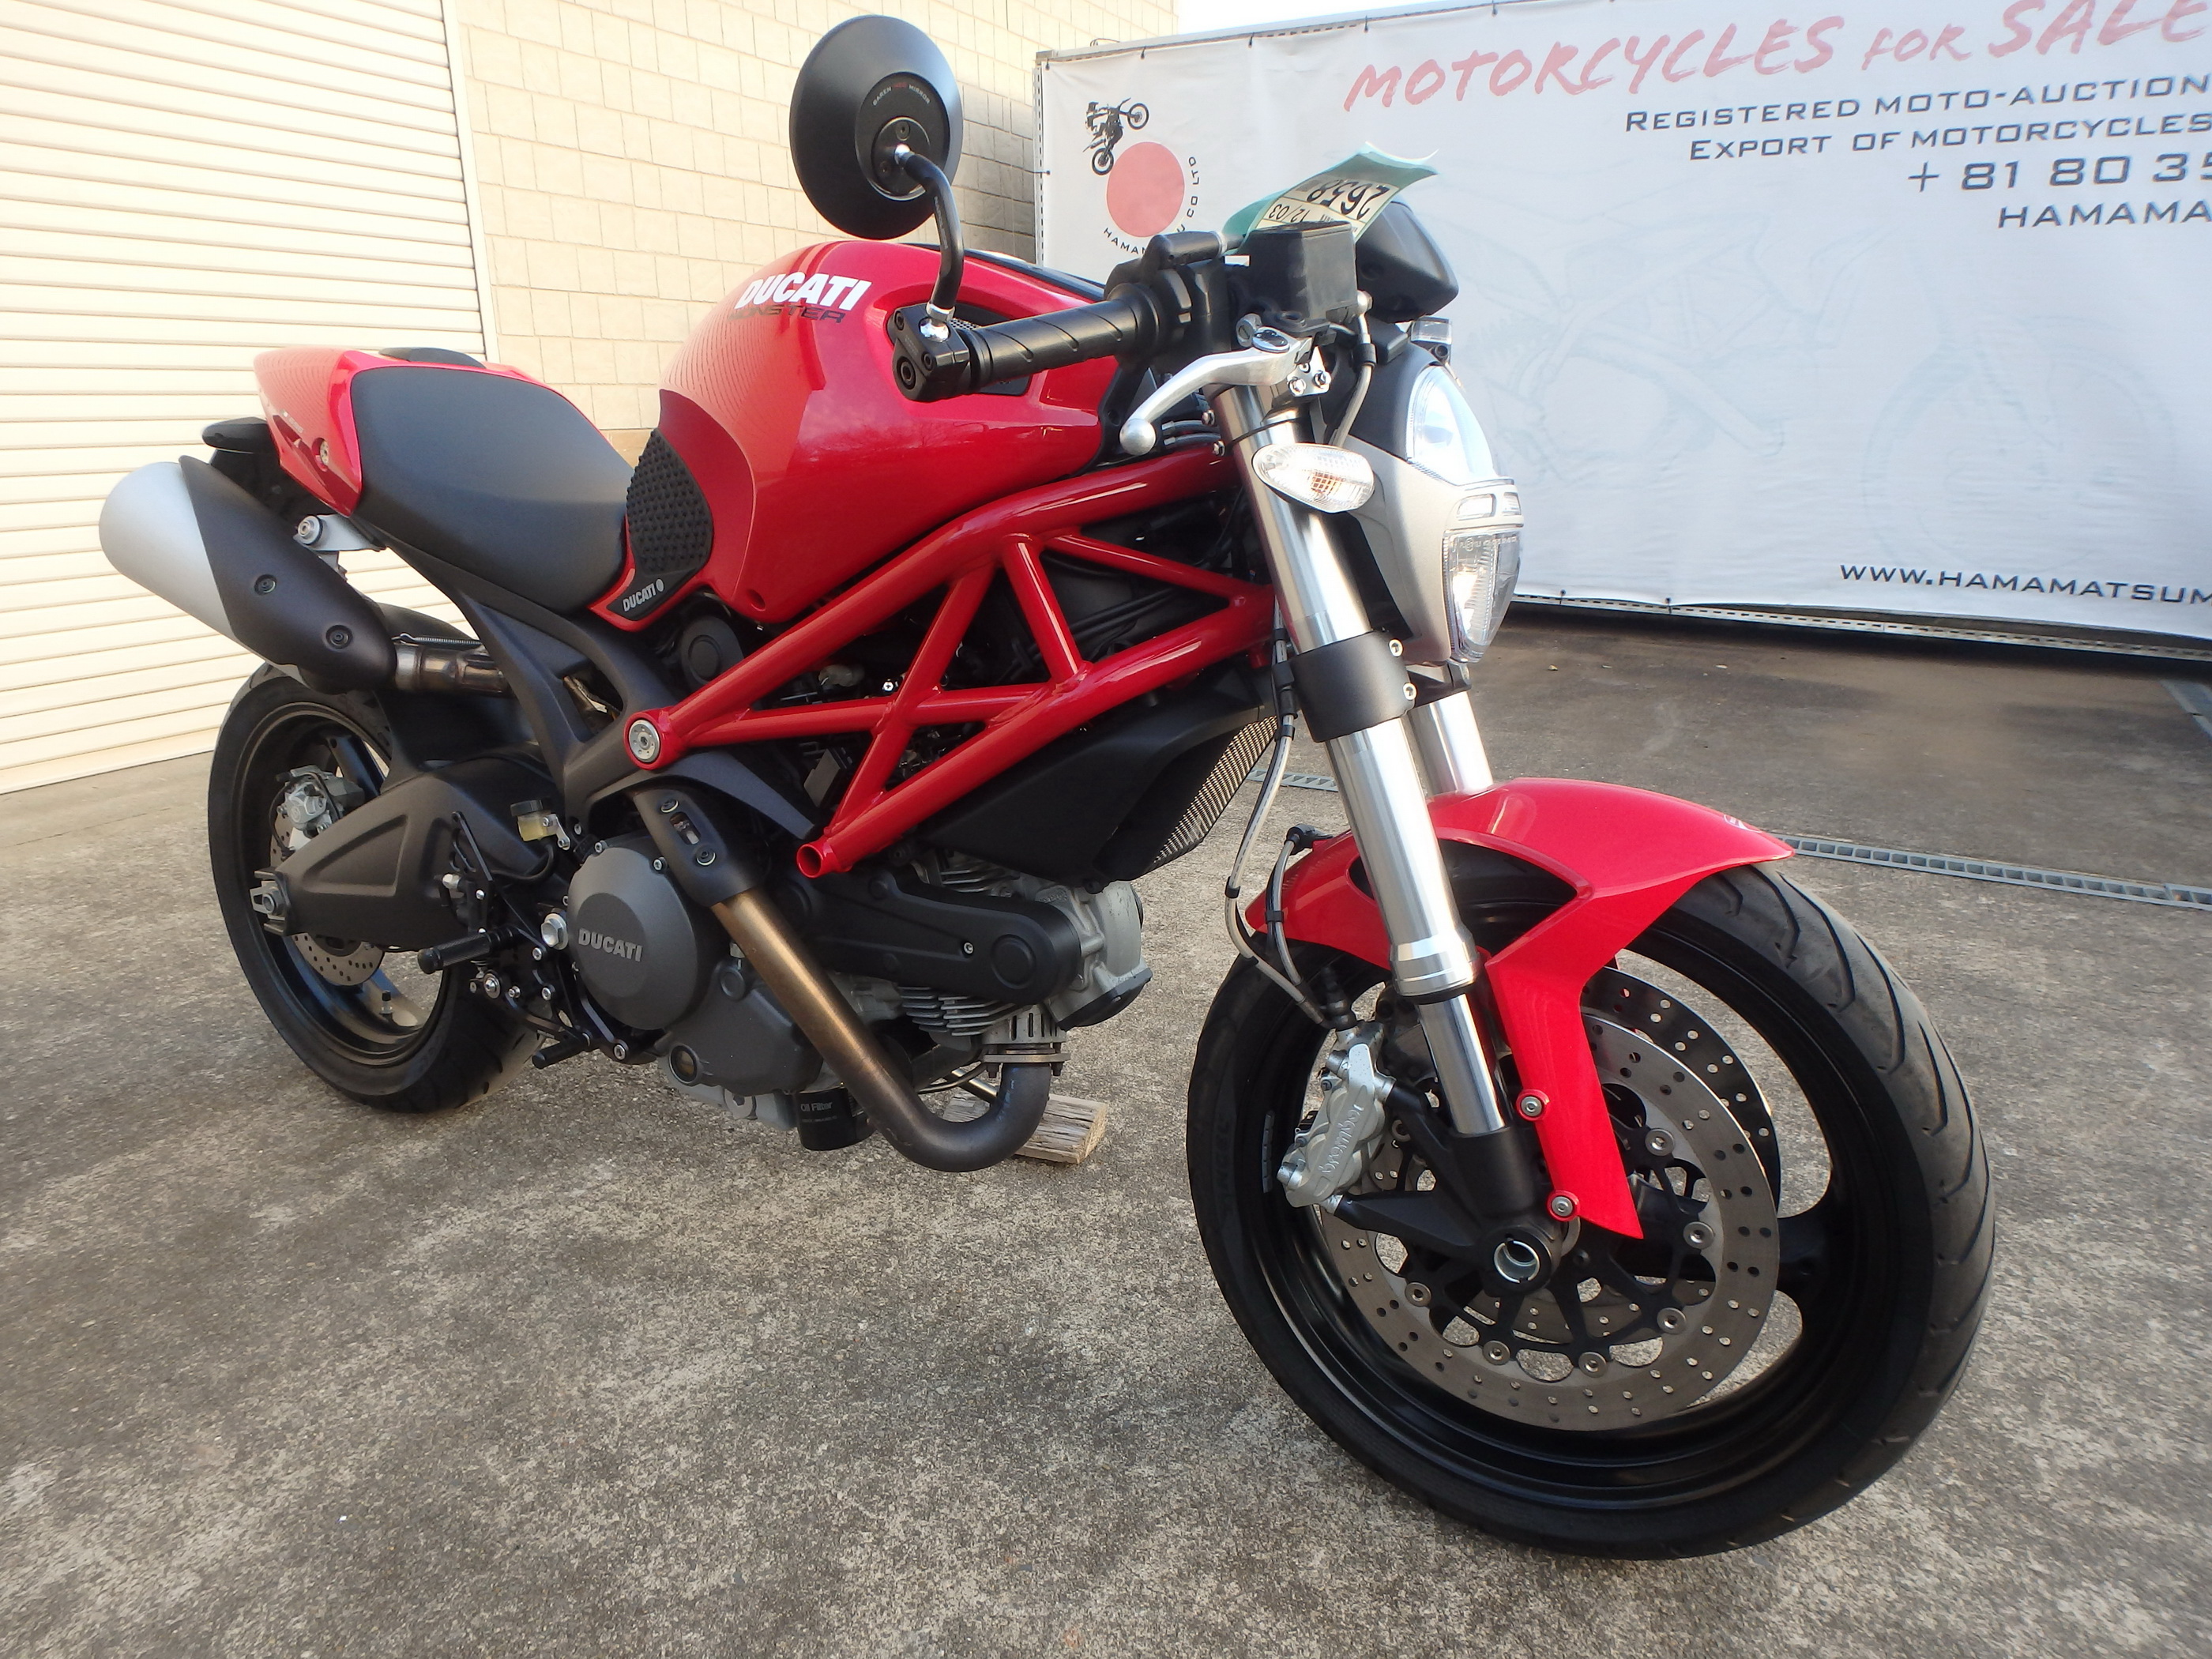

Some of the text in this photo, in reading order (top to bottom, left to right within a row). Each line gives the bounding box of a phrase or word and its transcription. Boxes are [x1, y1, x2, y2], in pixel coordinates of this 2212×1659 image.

[1343, 15, 1845, 112] MOTORCYCLES
[1988, 0, 2210, 58] SALE
[1625, 99, 1860, 133] REGISTERED
[1689, 112, 2212, 161] EXPORT OF MOTORCYCLES
[1961, 160, 2019, 190] 81
[2049, 156, 2131, 186] 80
[1307, 179, 1390, 220] 2658
[1998, 200, 2212, 228] HAMAMA
[734, 271, 872, 311] DUCATI
[623, 582, 656, 612] DUCATI
[578, 927, 643, 962] DUCATI
[1319, 1108, 1360, 1173] brembo
